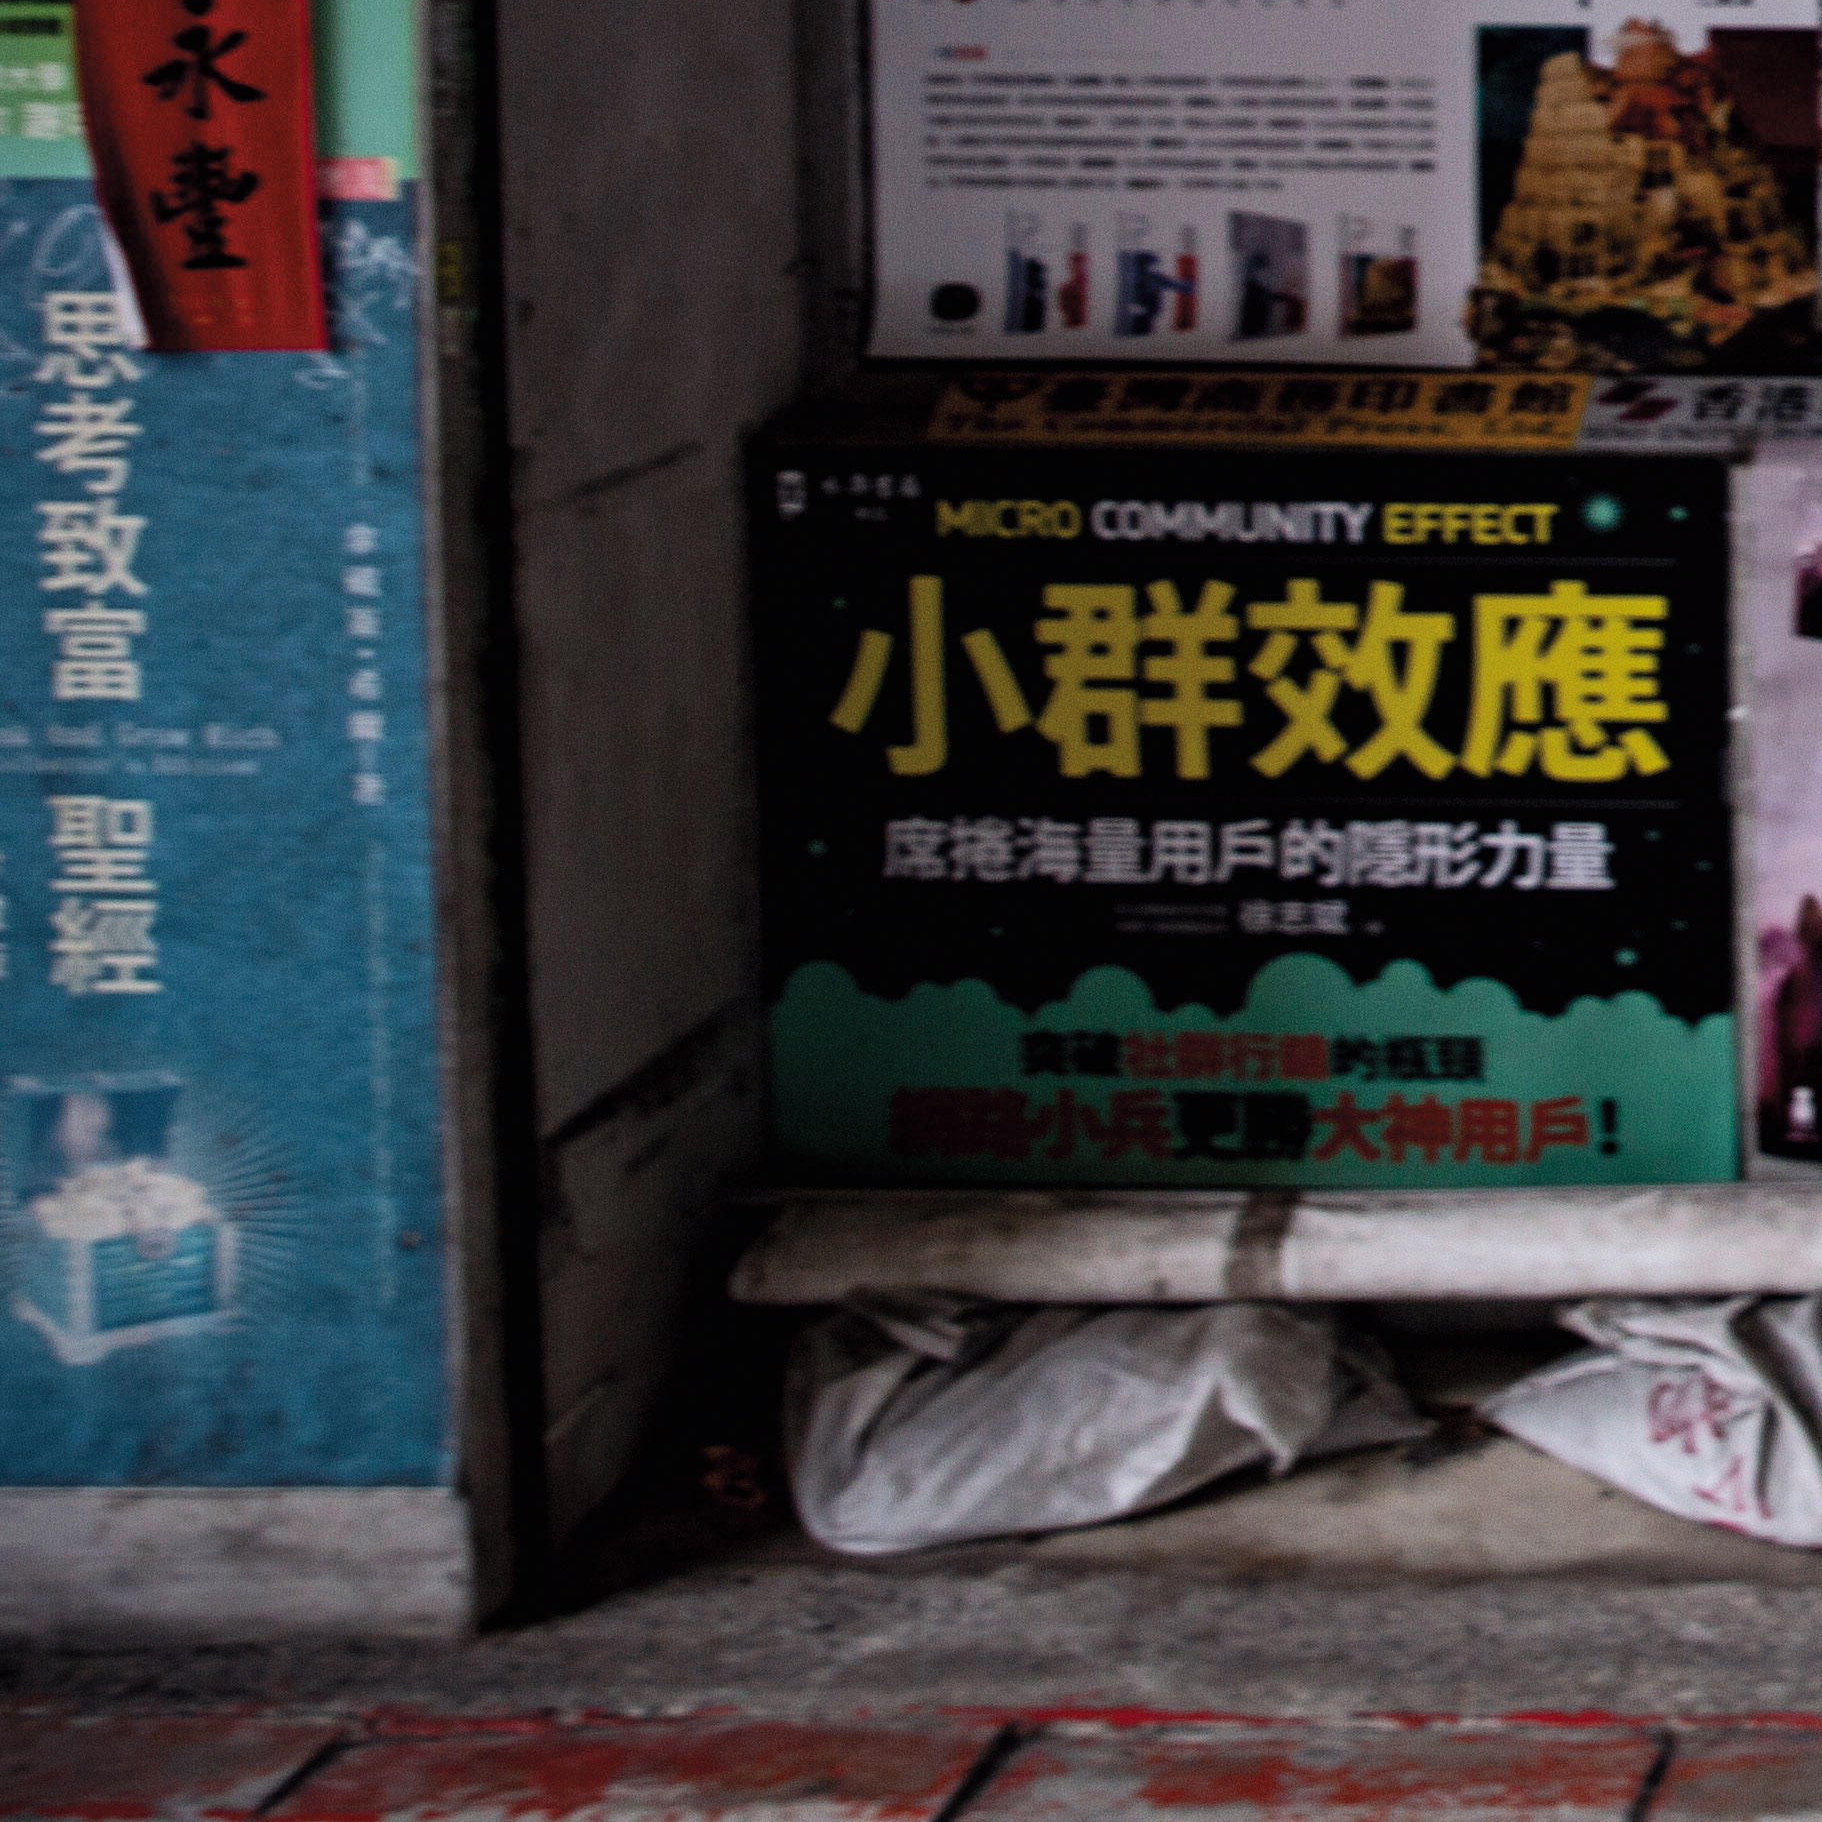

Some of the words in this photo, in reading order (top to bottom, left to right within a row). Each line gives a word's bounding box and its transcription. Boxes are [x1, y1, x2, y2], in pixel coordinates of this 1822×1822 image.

[32, 292, 152, 702] 思考致富
[937, 503, 1081, 538] MICRO
[1092, 503, 1372, 542] COMMUNITY
[1383, 504, 1560, 544] EFFECT
[828, 574, 1672, 782] 小群效應
[46, 794, 164, 996] 聖經
[884, 818, 1616, 890] 席捲海量用戶的隱形力量
